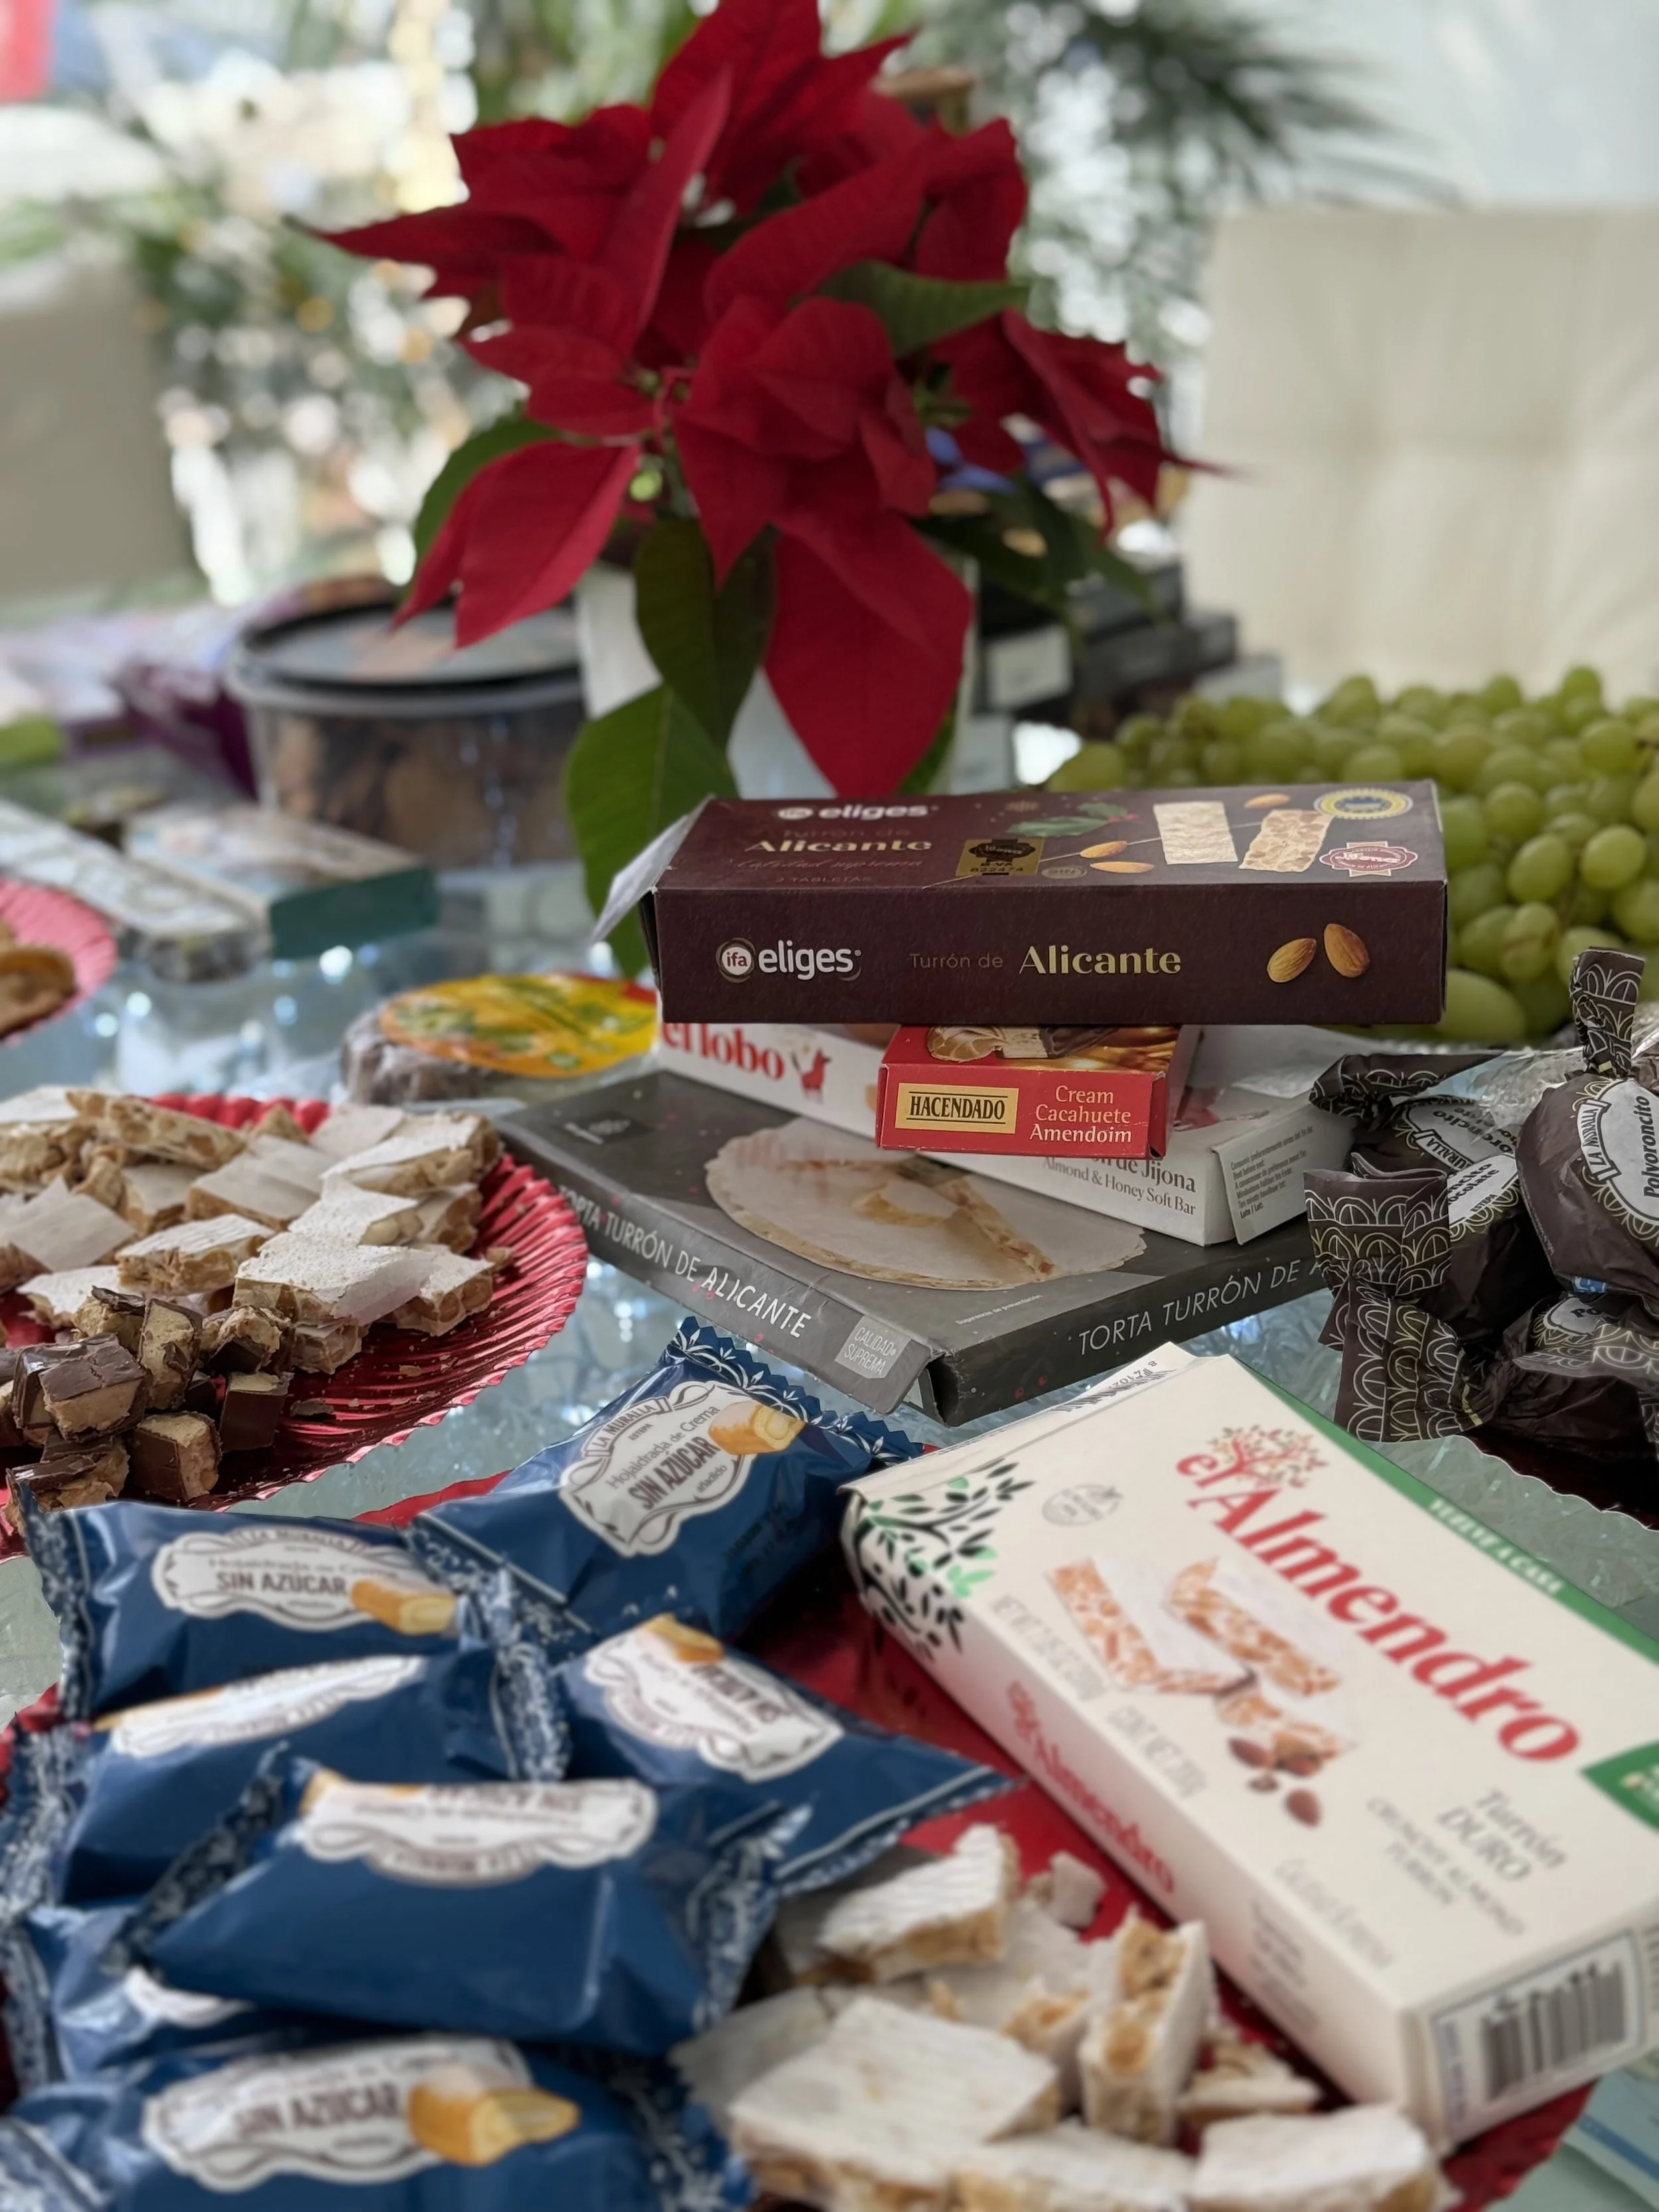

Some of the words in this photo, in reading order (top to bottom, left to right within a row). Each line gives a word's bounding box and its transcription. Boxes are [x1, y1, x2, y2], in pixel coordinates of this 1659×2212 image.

[818, 804, 928, 821] eliges
[745, 840, 933, 853] Alicante
[727, 952, 748, 967] ifa
[758, 940, 854, 980] eliges
[909, 953, 971, 969] Turrón
[978, 954, 1004, 969] de
[1019, 944, 1183, 974] Alicante
[910, 1095, 1005, 1120] HACENDADO
[1055, 1085, 1114, 1105] Cream
[1035, 1104, 1131, 1124] Cacahuete
[1581, 1108, 1600, 1148] MURALLA
[1029, 1123, 1132, 1143] Amendoim
[1633, 1095, 1659, 1199] Polvoroncito
[1587, 1151, 1607, 1166] LA
[1043, 1156, 1090, 1181] Almond
[1091, 1170, 1104, 1186] &
[1105, 1173, 1145, 1202] Honey
[1147, 1187, 1173, 1209] Soft
[1175, 1195, 1196, 1216] Bar
[1141, 1159, 1196, 1193] Jijona
[1240, 1208, 1251, 1218] Lote
[1254, 1202, 1264, 1212] Lot:
[1470, 1193, 1498, 1213] ESTEPA
[605, 1211, 672, 1269] TURRÓN
[676, 1250, 702, 1284] DE
[701, 1266, 812, 1339] ALICANTE
[1077, 1309, 1153, 1355] TORTA
[1162, 1272, 1262, 1327] TURRÓN
[1269, 1259, 1301, 1290] DE
[854, 1327, 895, 1357] CALIDAD
[844, 1343, 887, 1375] SUPREMA
[598, 1434, 611, 1449] LA
[609, 1404, 656, 1436] MURALLA
[628, 1423, 654, 1441] ESTEPA
[605, 1439, 673, 1491] Hojaldrada
[669, 1431, 685, 1445] de
[680, 1405, 721, 1434] Crema
[627, 1475, 670, 1511] SIN
[659, 1436, 723, 1489] AZÚCAR
[696, 1463, 729, 1494] añadido
[216, 1572, 255, 1591] SIN
[1187, 1487, 1582, 1763] Almendro
[1436, 1805, 1533, 1882] DURO
